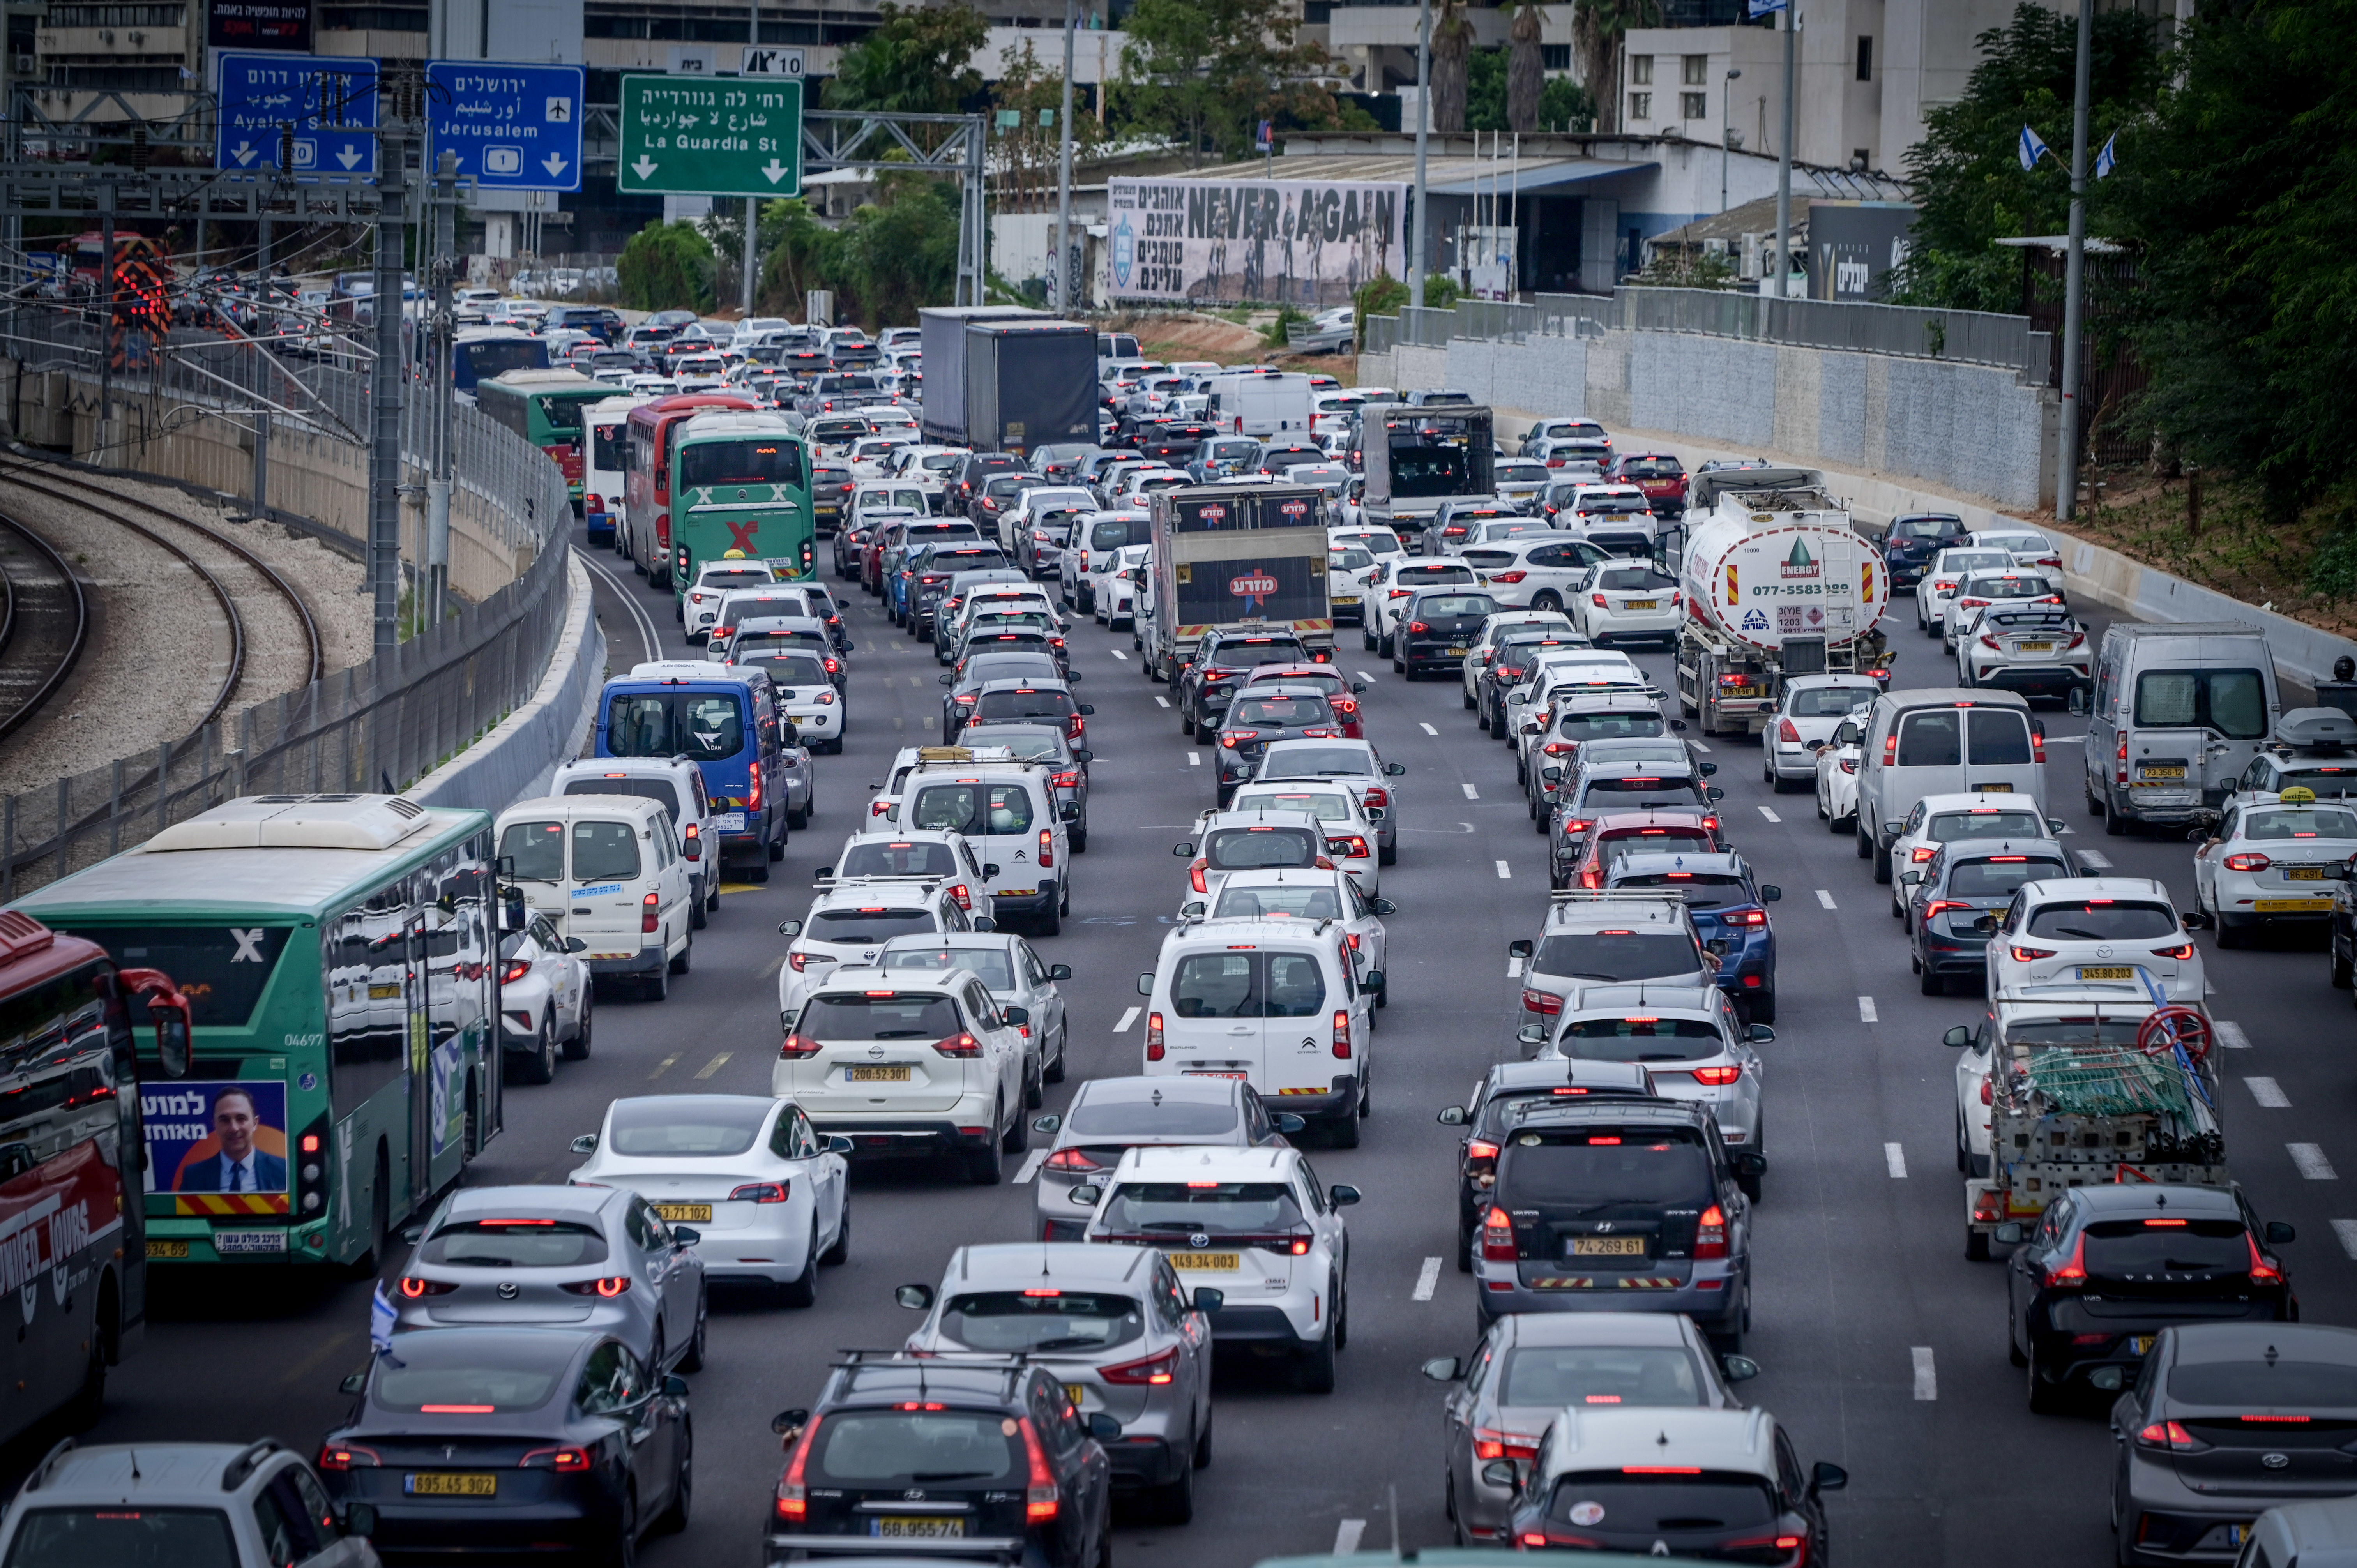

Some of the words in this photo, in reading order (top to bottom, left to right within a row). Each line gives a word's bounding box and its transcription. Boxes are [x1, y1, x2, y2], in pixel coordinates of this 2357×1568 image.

[682, 59, 703, 70] בית
[780, 58, 800, 74] 10
[247, 69, 288, 85] דרום
[455, 75, 525, 93] ירושלים
[247, 93, 292, 109] جنوب
[641, 89, 716, 106] גוורדייה
[725, 91, 747, 107] לה
[455, 96, 521, 120] أورشليم
[233, 114, 297, 131] Ayalon
[308, 116, 363, 130] Sth
[710, 111, 719, 125] لا
[728, 112, 767, 132] شارع
[440, 120, 538, 138] Jerusalem
[645, 134, 667, 148] La
[676, 134, 749, 152] Guardia
[758, 137, 777, 152] St
[499, 155, 505, 166] 1
[1138, 185, 1185, 210] אוהבים
[1188, 186, 1281, 241] NEVER
[1142, 213, 1184, 236] אתכם.
[1137, 240, 1183, 266] סומכים
[1136, 263, 1183, 292] עליכם.
[1781, 565, 1818, 575] ENERGY
[1233, 579, 1274, 592] מזרע
[1779, 607, 1801, 616] 3(Y)E
[285, 1034, 322, 1047] 04697
[47, 1198, 89, 1266] TOURS
[223, 1234, 239, 1245] עשן
[261, 1234, 281, 1244] הרכב
[2125, 1273, 2212, 1281] VOLVO
